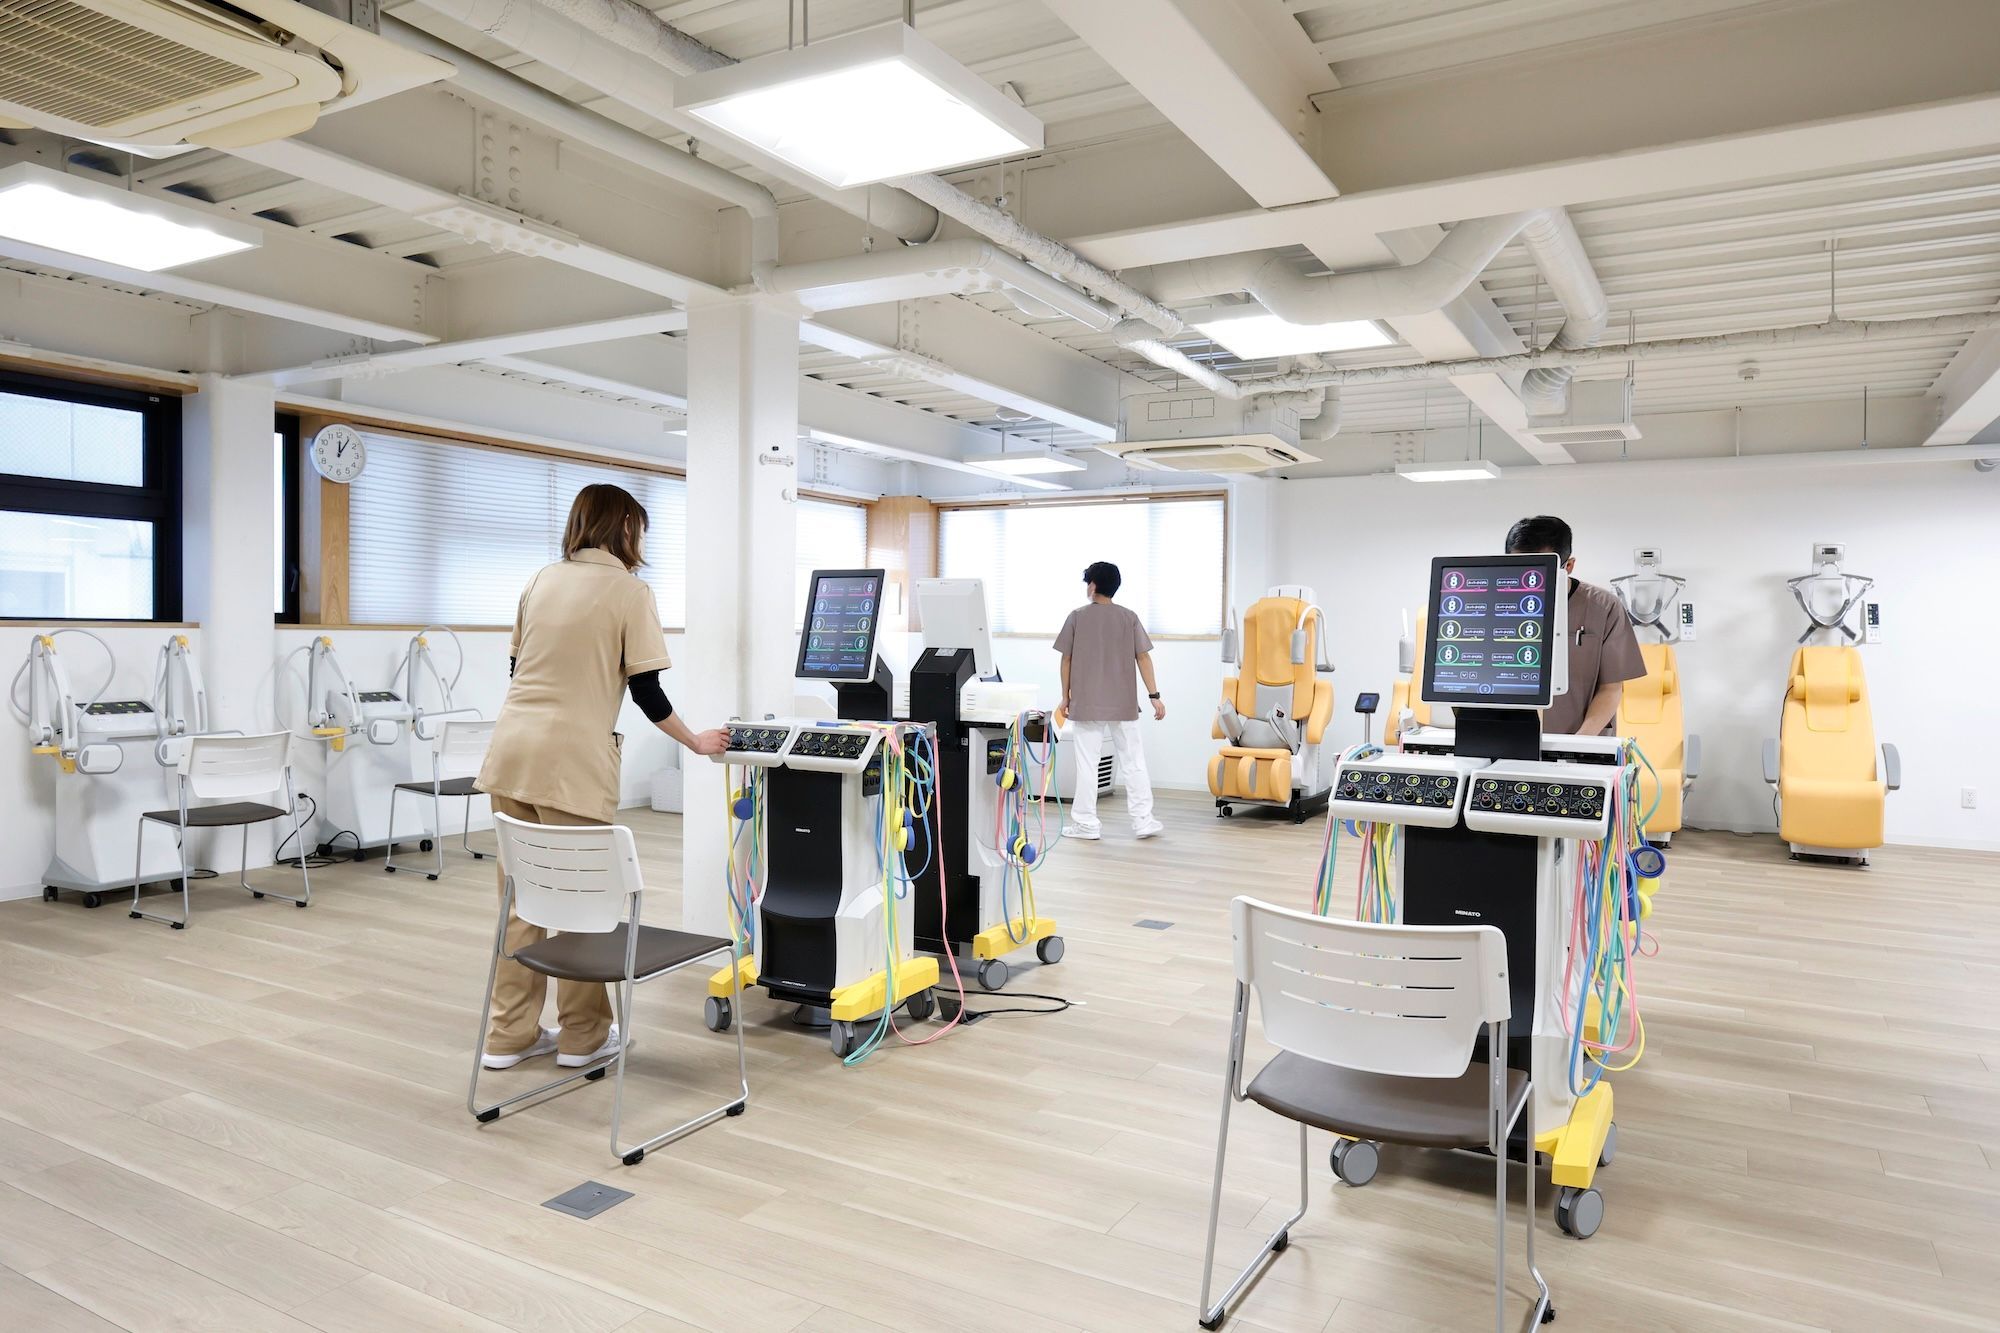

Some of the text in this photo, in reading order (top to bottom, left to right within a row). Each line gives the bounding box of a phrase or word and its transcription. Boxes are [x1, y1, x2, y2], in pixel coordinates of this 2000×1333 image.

[1450, 576, 1458, 587] 8
[1529, 575, 1536, 586] 8
[1448, 600, 1456, 611] 8
[1527, 600, 1535, 610] 8
[1447, 625, 1454, 635] 8
[1526, 625, 1533, 636] 8
[1445, 649, 1452, 660] 8
[1524, 650, 1532, 661] 8
